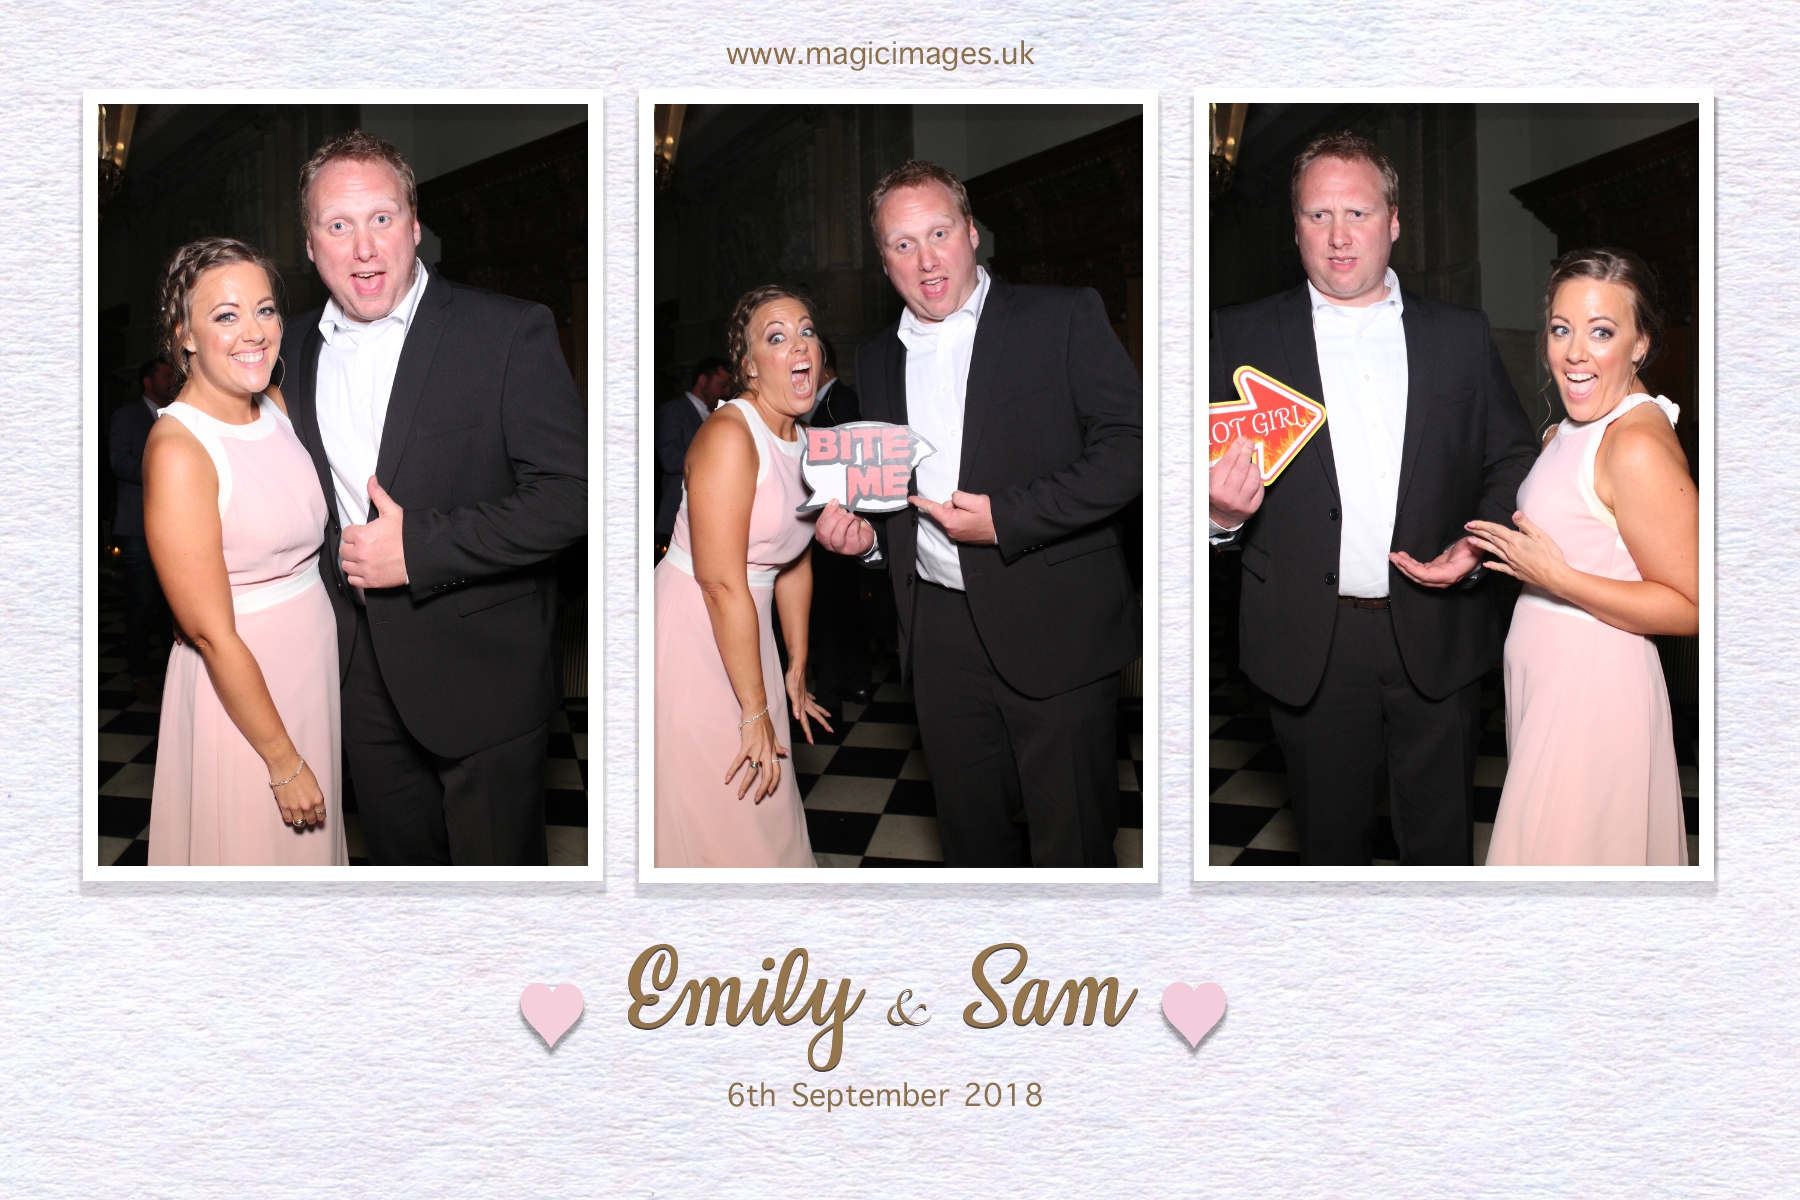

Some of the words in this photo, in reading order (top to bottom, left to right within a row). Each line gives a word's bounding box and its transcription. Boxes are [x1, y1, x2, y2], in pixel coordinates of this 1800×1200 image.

[808, 427, 912, 462] BITE
[1209, 416, 1247, 446] OT
[1252, 404, 1309, 437] GIRL
[847, 464, 910, 506] ME
